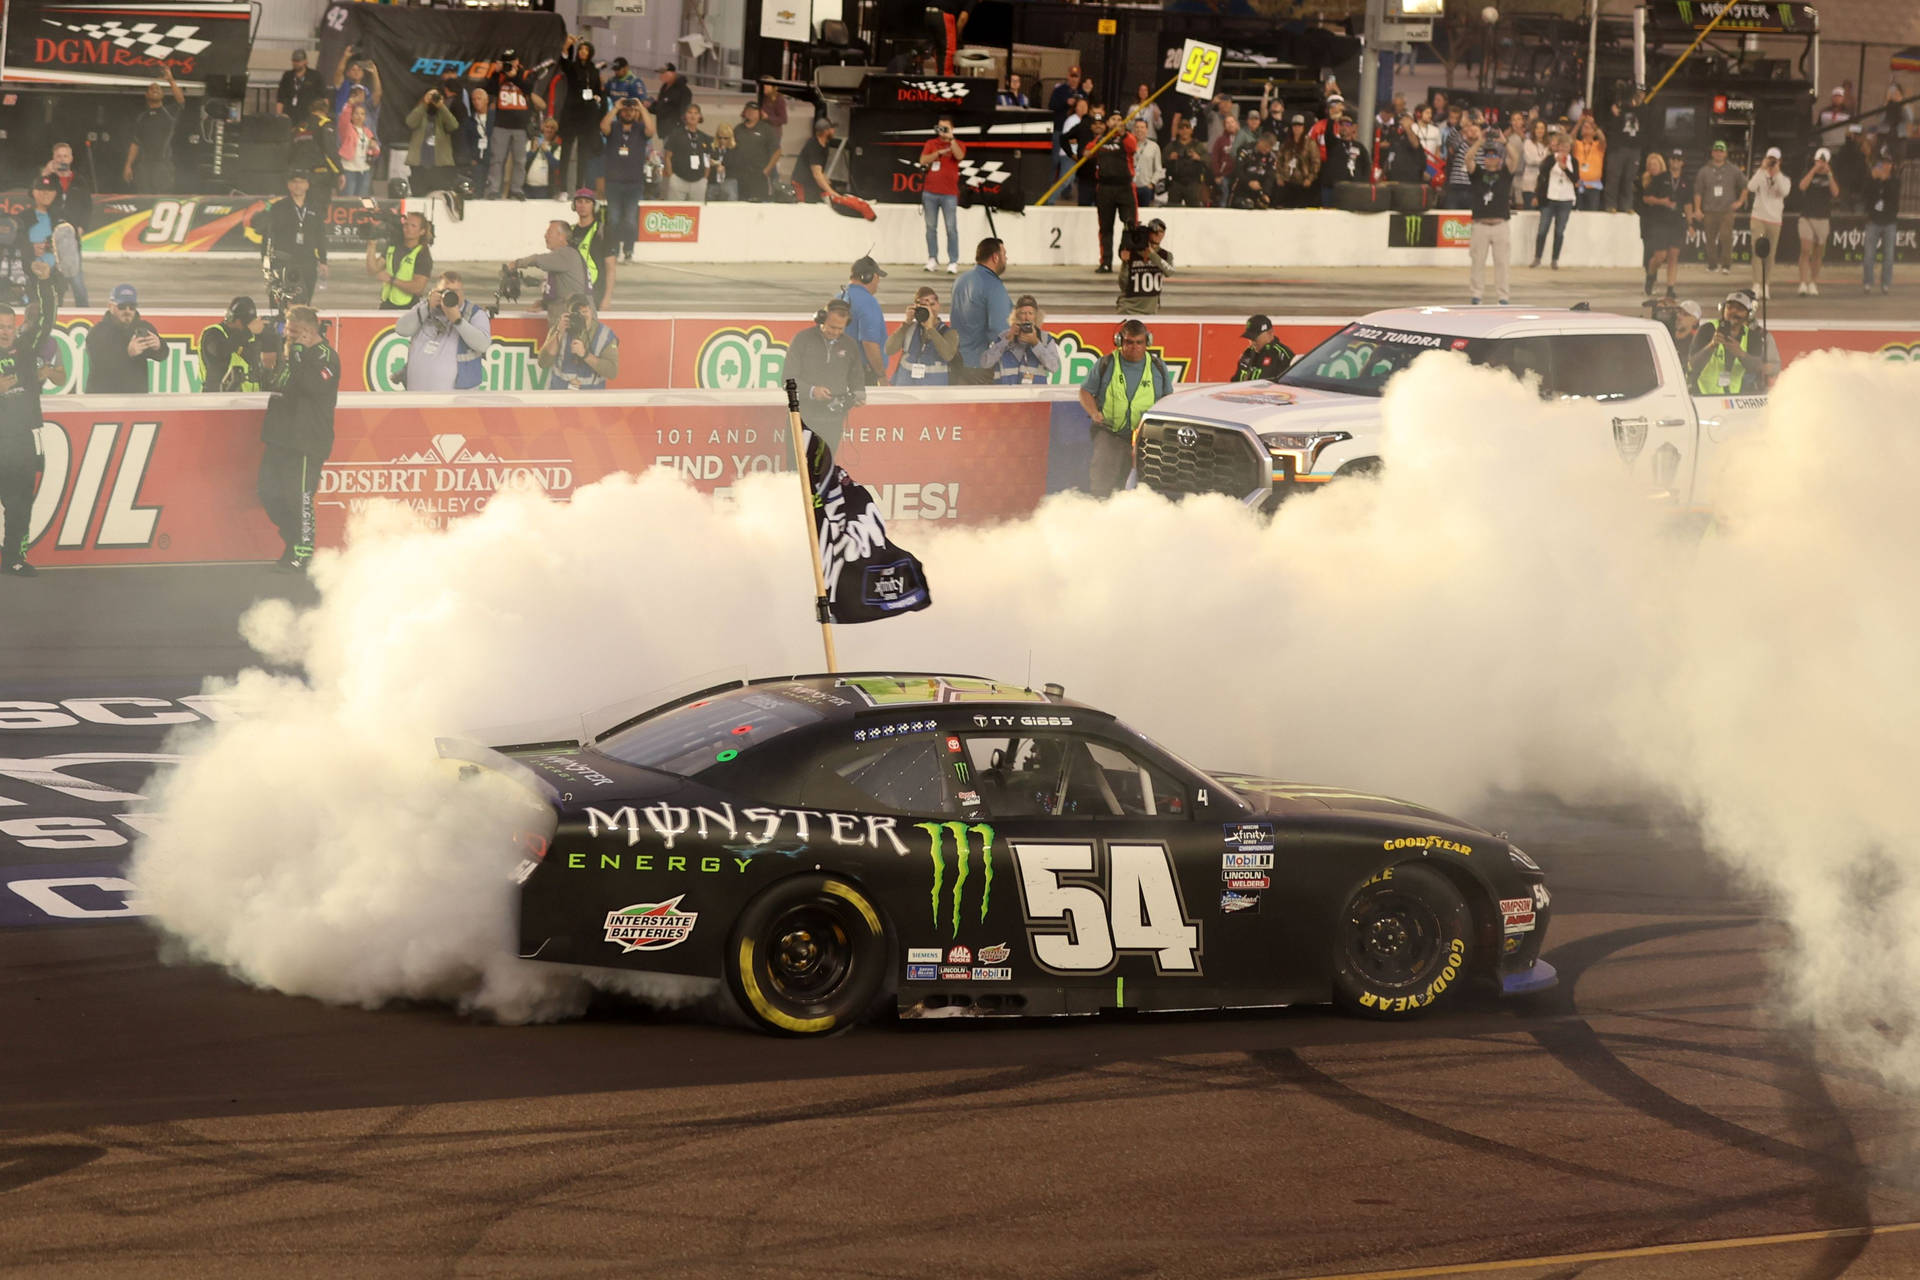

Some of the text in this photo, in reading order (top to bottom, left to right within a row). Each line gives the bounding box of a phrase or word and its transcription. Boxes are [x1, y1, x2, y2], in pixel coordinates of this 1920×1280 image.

[34, 38, 110, 63] DGM
[1180, 46, 1219, 88] 92
[897, 88, 928, 102] DGM
[891, 172, 923, 192] DG
[145, 201, 197, 243] 91
[1049, 227, 1062, 249] 2
[1353, 327, 1442, 347] 2022 TUNDRA
[655, 429, 694, 444] 101
[708, 428, 758, 444] AND
[918, 426, 964, 442] AVE
[318, 467, 573, 494] DESERT DIAMOND
[990, 715, 1015, 727] TY
[582, 801, 912, 857] MONSTER
[1232, 829, 1266, 843] xfinity
[1383, 835, 1473, 857] GOODYEAR
[567, 852, 754, 874] ENERGY
[1225, 855, 1257, 866] Mobil
[1224, 871, 1262, 880] LINCOLN
[1231, 880, 1266, 888] WELDERS
[1007, 839, 1203, 976] 54
[1500, 900, 1532, 913] SIMPSON
[609, 915, 692, 927] INTERSTATE
[611, 928, 685, 938] BATTERIES
[974, 968, 999, 978] Mobil
[1359, 938, 1465, 1012] GOODYEAR
